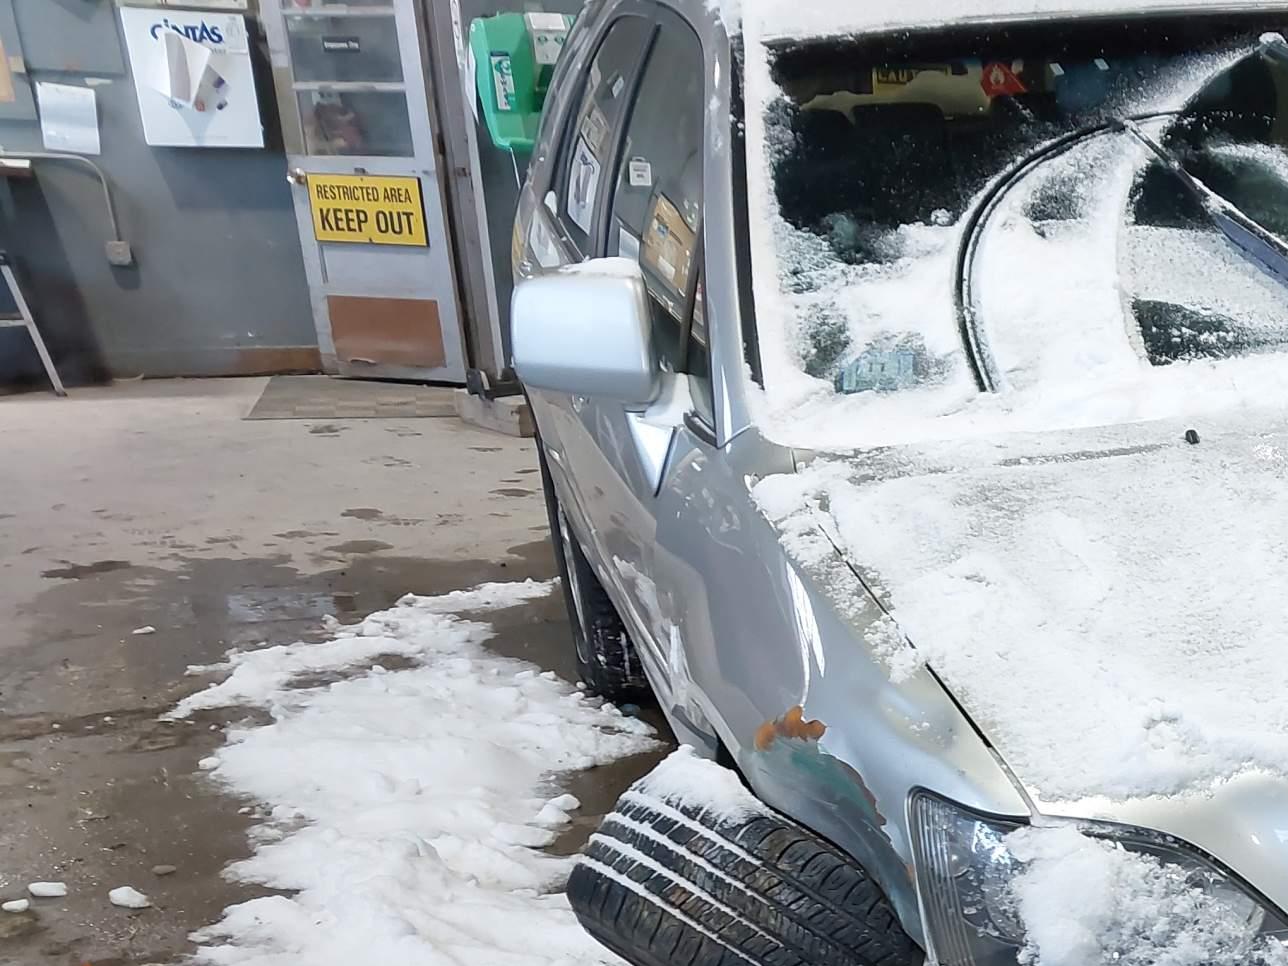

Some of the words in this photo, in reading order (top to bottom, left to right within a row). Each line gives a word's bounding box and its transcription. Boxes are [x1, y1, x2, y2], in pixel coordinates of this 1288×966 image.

[316, 184, 379, 202] RESTRICTED
[383, 187, 413, 204] AREA
[319, 207, 368, 233] KEEP
[375, 210, 414, 235] OUT
